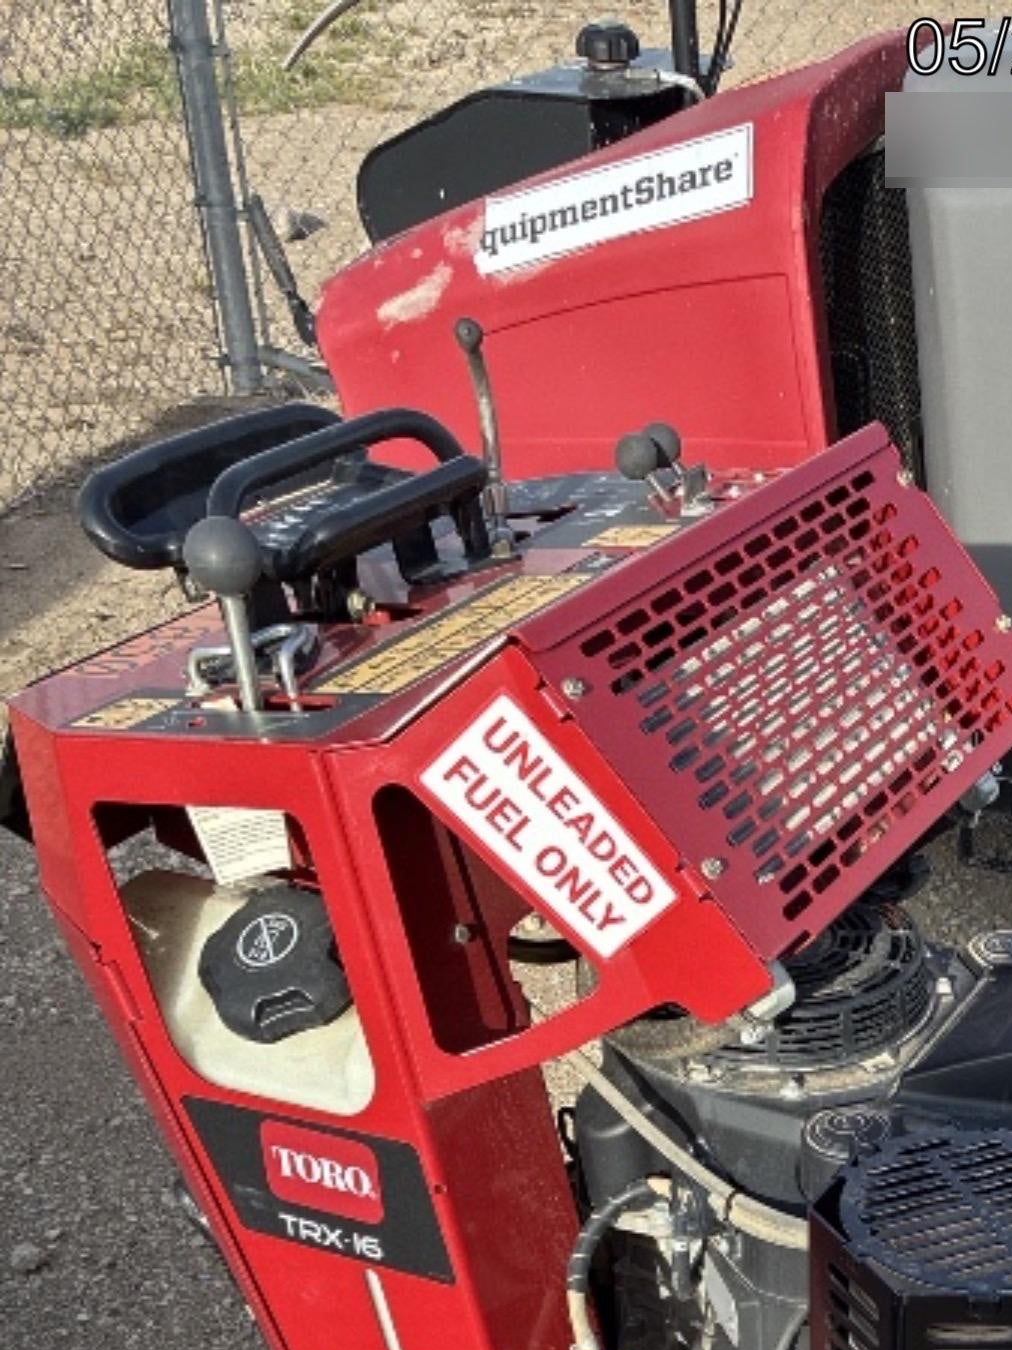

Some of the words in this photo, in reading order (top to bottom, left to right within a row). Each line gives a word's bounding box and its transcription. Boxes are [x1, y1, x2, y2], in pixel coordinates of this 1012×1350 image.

[423, 755, 532, 853] FUEL
[534, 845, 626, 931] ONLY
[482, 716, 654, 905] UNLEADED
[270, 1145, 372, 1198] TORO
[278, 1211, 384, 1260] TRX-16
